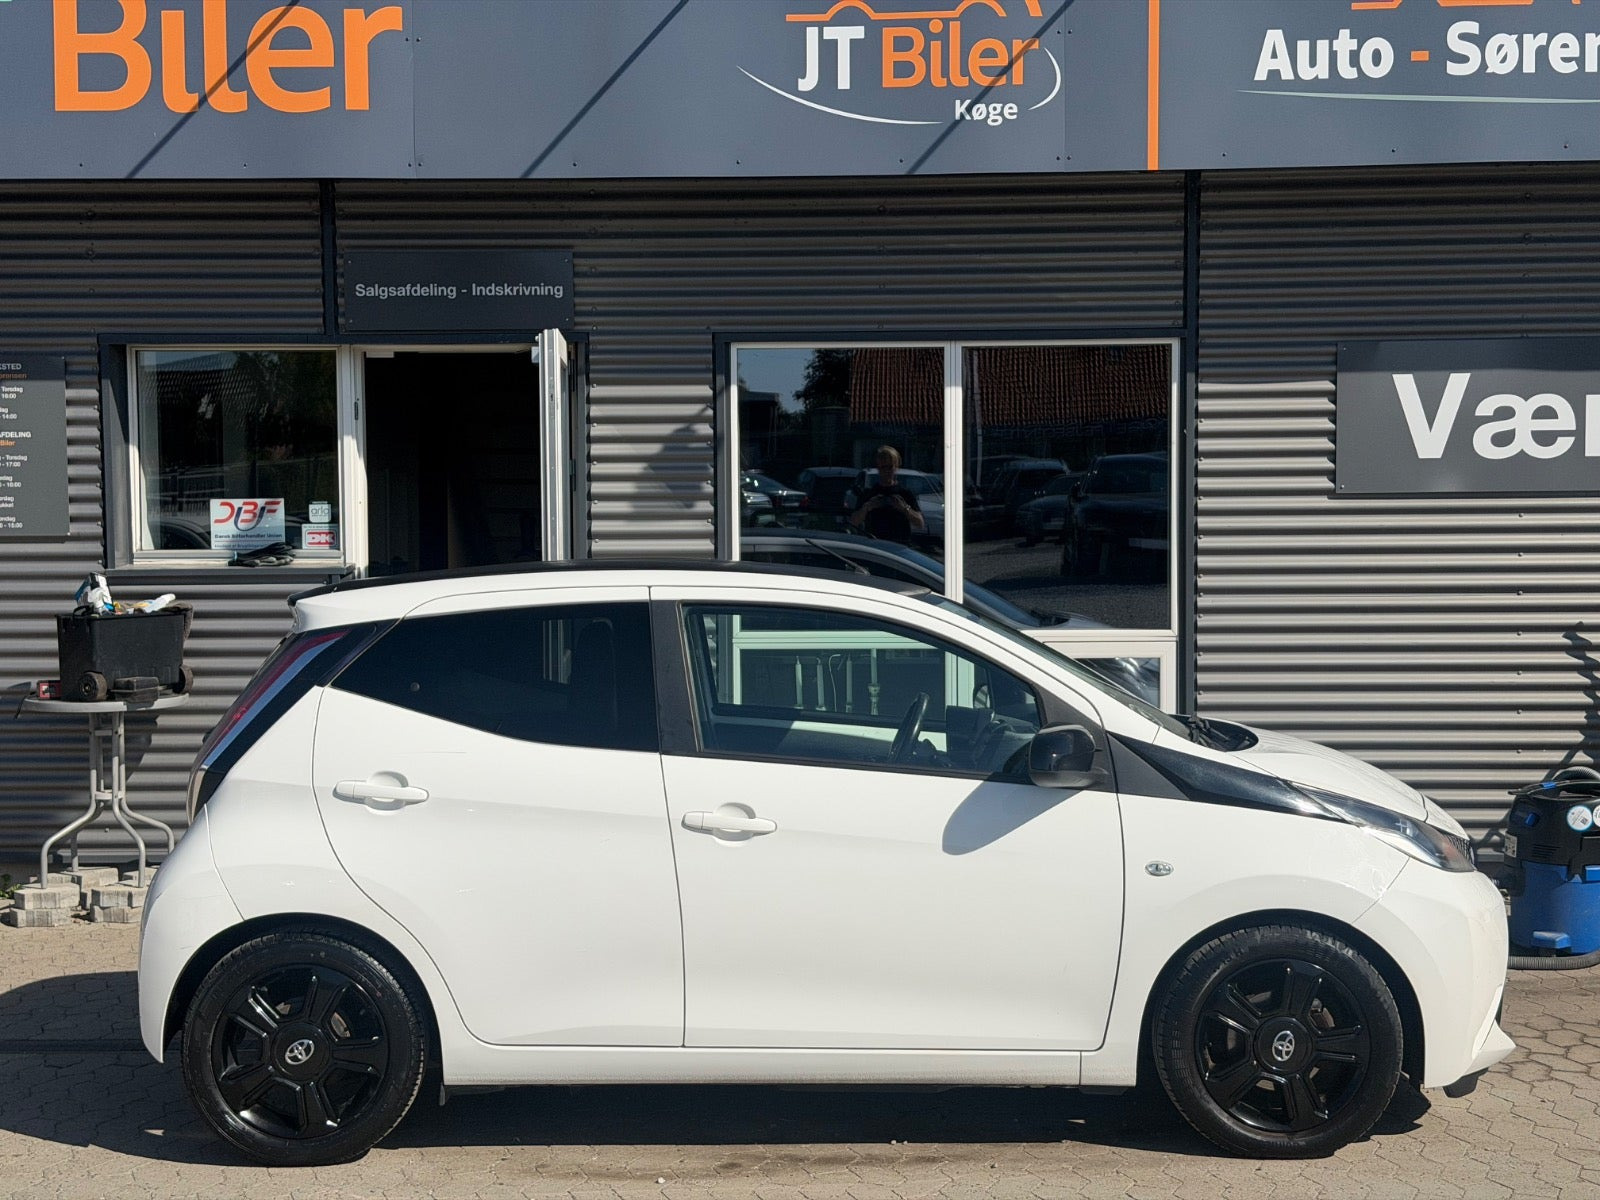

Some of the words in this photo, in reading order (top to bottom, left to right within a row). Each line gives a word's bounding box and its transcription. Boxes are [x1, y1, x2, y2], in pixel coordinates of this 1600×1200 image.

[53, 0, 403, 113] Biler
[798, 26, 865, 91] JT
[882, 19, 1039, 87] Biler
[1254, 29, 1394, 81] Auto
[955, 99, 1018, 126] Køge
[355, 283, 457, 299] Salgsafdeling
[472, 283, 564, 298] Indskrivning
